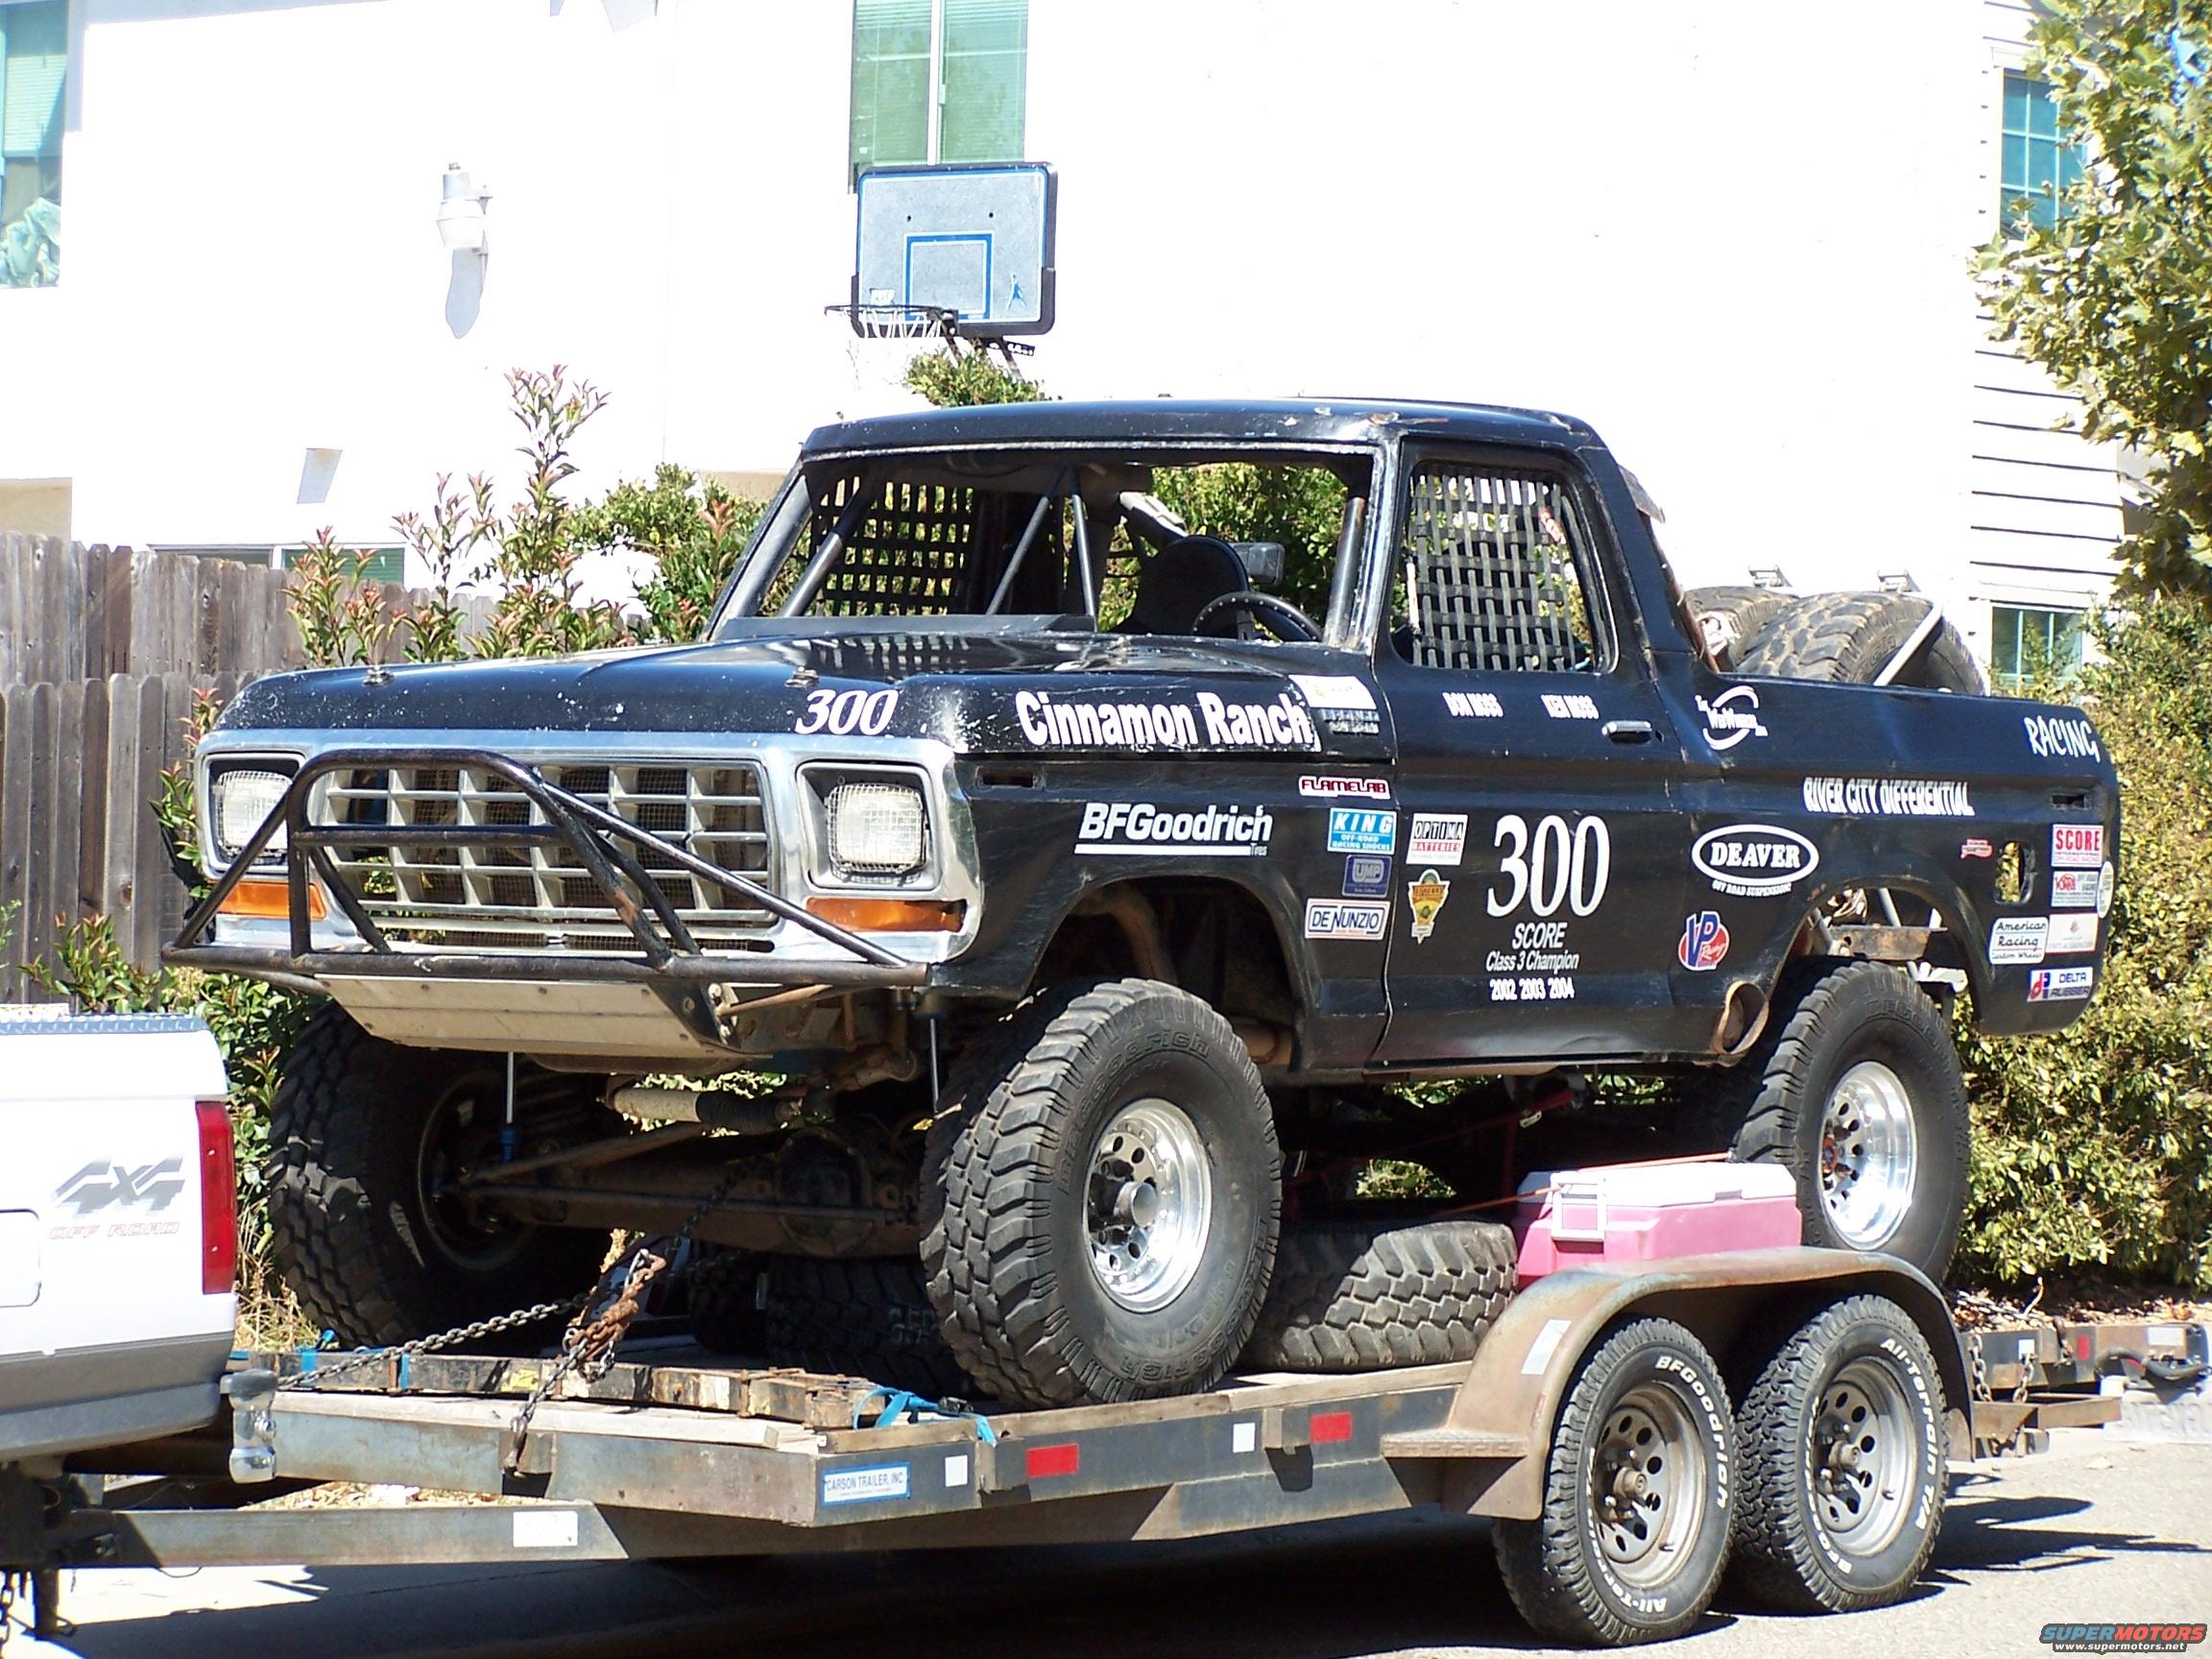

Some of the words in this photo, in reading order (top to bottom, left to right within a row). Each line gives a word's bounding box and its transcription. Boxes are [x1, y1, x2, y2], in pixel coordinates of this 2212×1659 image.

[794, 688, 900, 735] 300
[1015, 690, 1198, 746] Cinnamon
[1196, 691, 1313, 746] Ranch
[2024, 715, 2101, 762] RACING
[1301, 779, 1386, 794] FLAMELAB
[1803, 777, 1845, 814] RIVER
[1845, 778, 1880, 814] CITY
[1880, 778, 1975, 816] DIFFERENTIAL
[1078, 802, 1274, 842] BFGoodrich
[1333, 812, 1393, 834] KING
[1414, 820, 1464, 840] OPTIMA
[1412, 842, 1461, 853] BATTERIES
[2056, 829, 2101, 852] SCORE
[1487, 814, 1611, 917] 300
[1710, 842, 1801, 869] DEAVER
[1311, 911, 1331, 927] DE
[1332, 911, 1381, 929] NUNZIO
[1996, 919, 2047, 931] American
[1512, 922, 1568, 950] SCORE
[1687, 913, 1719, 967] VP
[1997, 934, 2038, 951] Racing
[1486, 950, 1517, 972] Class
[1517, 950, 1527, 972] 3
[1526, 949, 1579, 974] Champion
[1490, 978, 1518, 1000] 2002
[1519, 977, 1546, 1000] 2003
[1548, 976, 1575, 999] 2004
[2058, 971, 2087, 984] DELTA
[50, 1225, 100, 1239] OFF
[108, 1221, 180, 1238] ROAD
[1880, 1337, 1938, 1476] All-Terrain
[1655, 1356, 1729, 1508] BFGoodrich
[827, 1477, 856, 1491] CARSON
